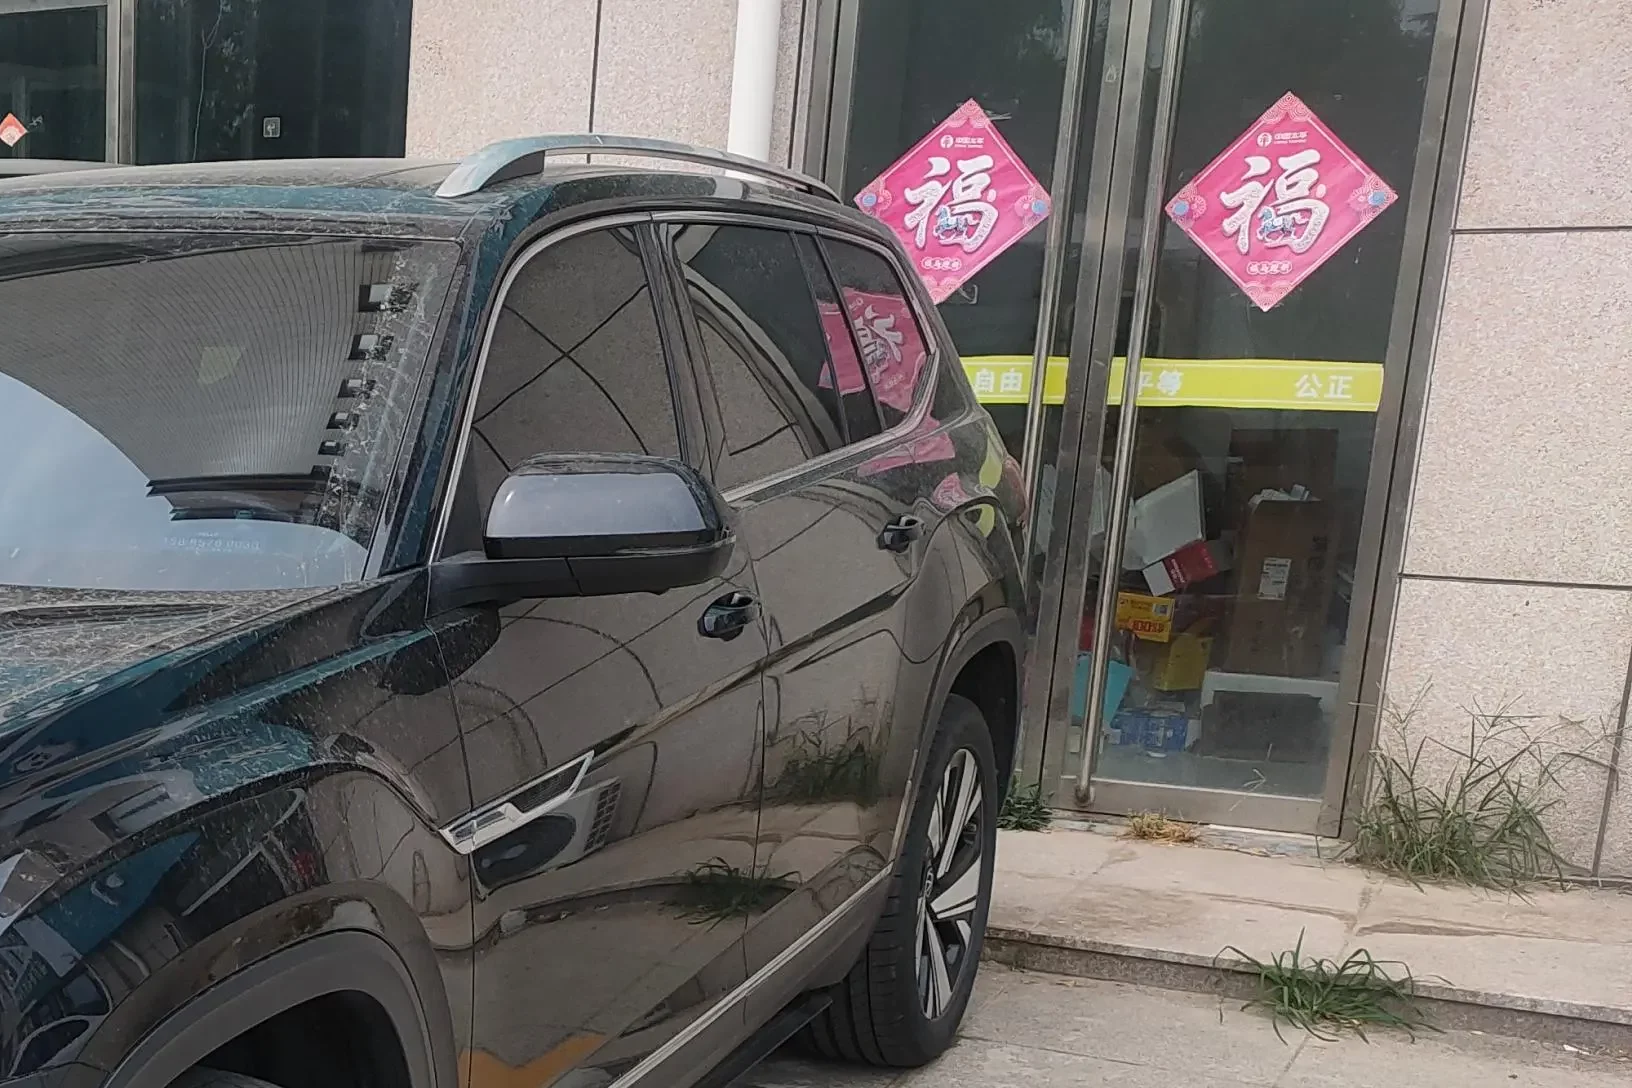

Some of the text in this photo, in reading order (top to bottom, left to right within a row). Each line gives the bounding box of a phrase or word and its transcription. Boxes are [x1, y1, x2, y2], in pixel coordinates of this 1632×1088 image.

[903, 154, 999, 254] 福
[1219, 149, 1330, 255] 福
[975, 368, 1023, 392] 自由
[1294, 374, 1353, 398] 公正
